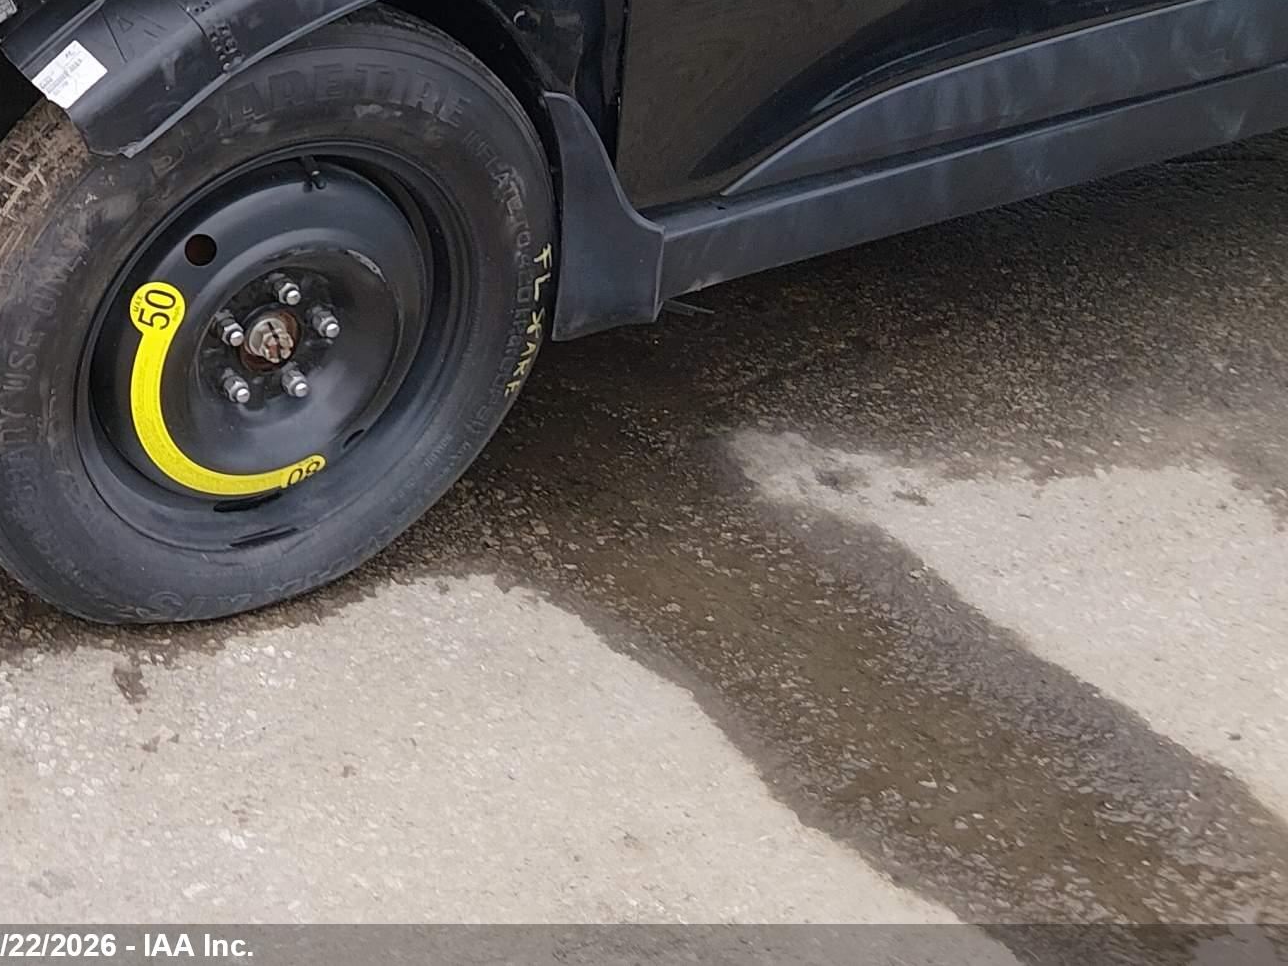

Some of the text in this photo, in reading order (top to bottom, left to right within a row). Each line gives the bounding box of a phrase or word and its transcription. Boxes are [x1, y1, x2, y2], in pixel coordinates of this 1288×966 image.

[356, 64, 471, 128] TIRE
[533, 243, 552, 302] FL
[137, 289, 177, 330] 50
[2, 328, 45, 392] USE
